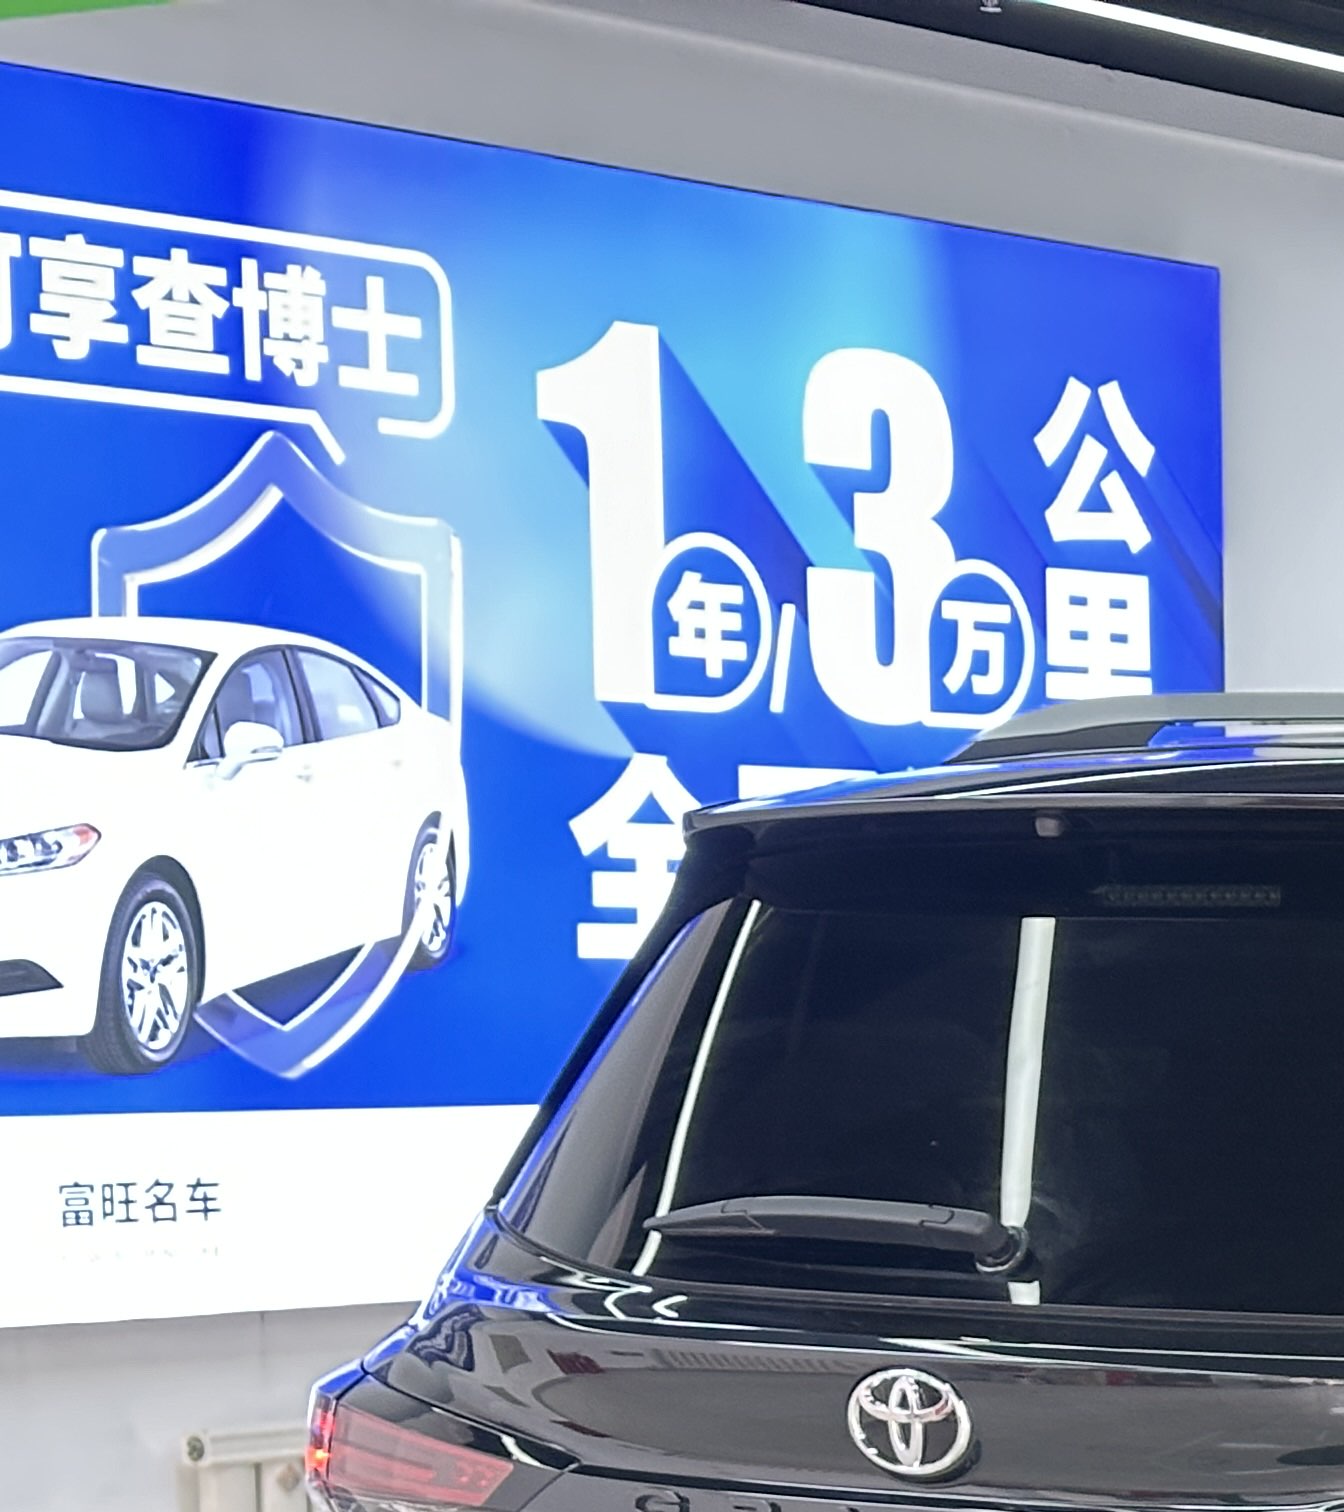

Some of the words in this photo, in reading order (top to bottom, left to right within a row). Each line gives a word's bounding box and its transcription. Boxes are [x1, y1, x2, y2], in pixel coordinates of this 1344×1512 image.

[0, 231, 423, 397] 享查博士
[58, 1177, 222, 1228] 富旺名车
